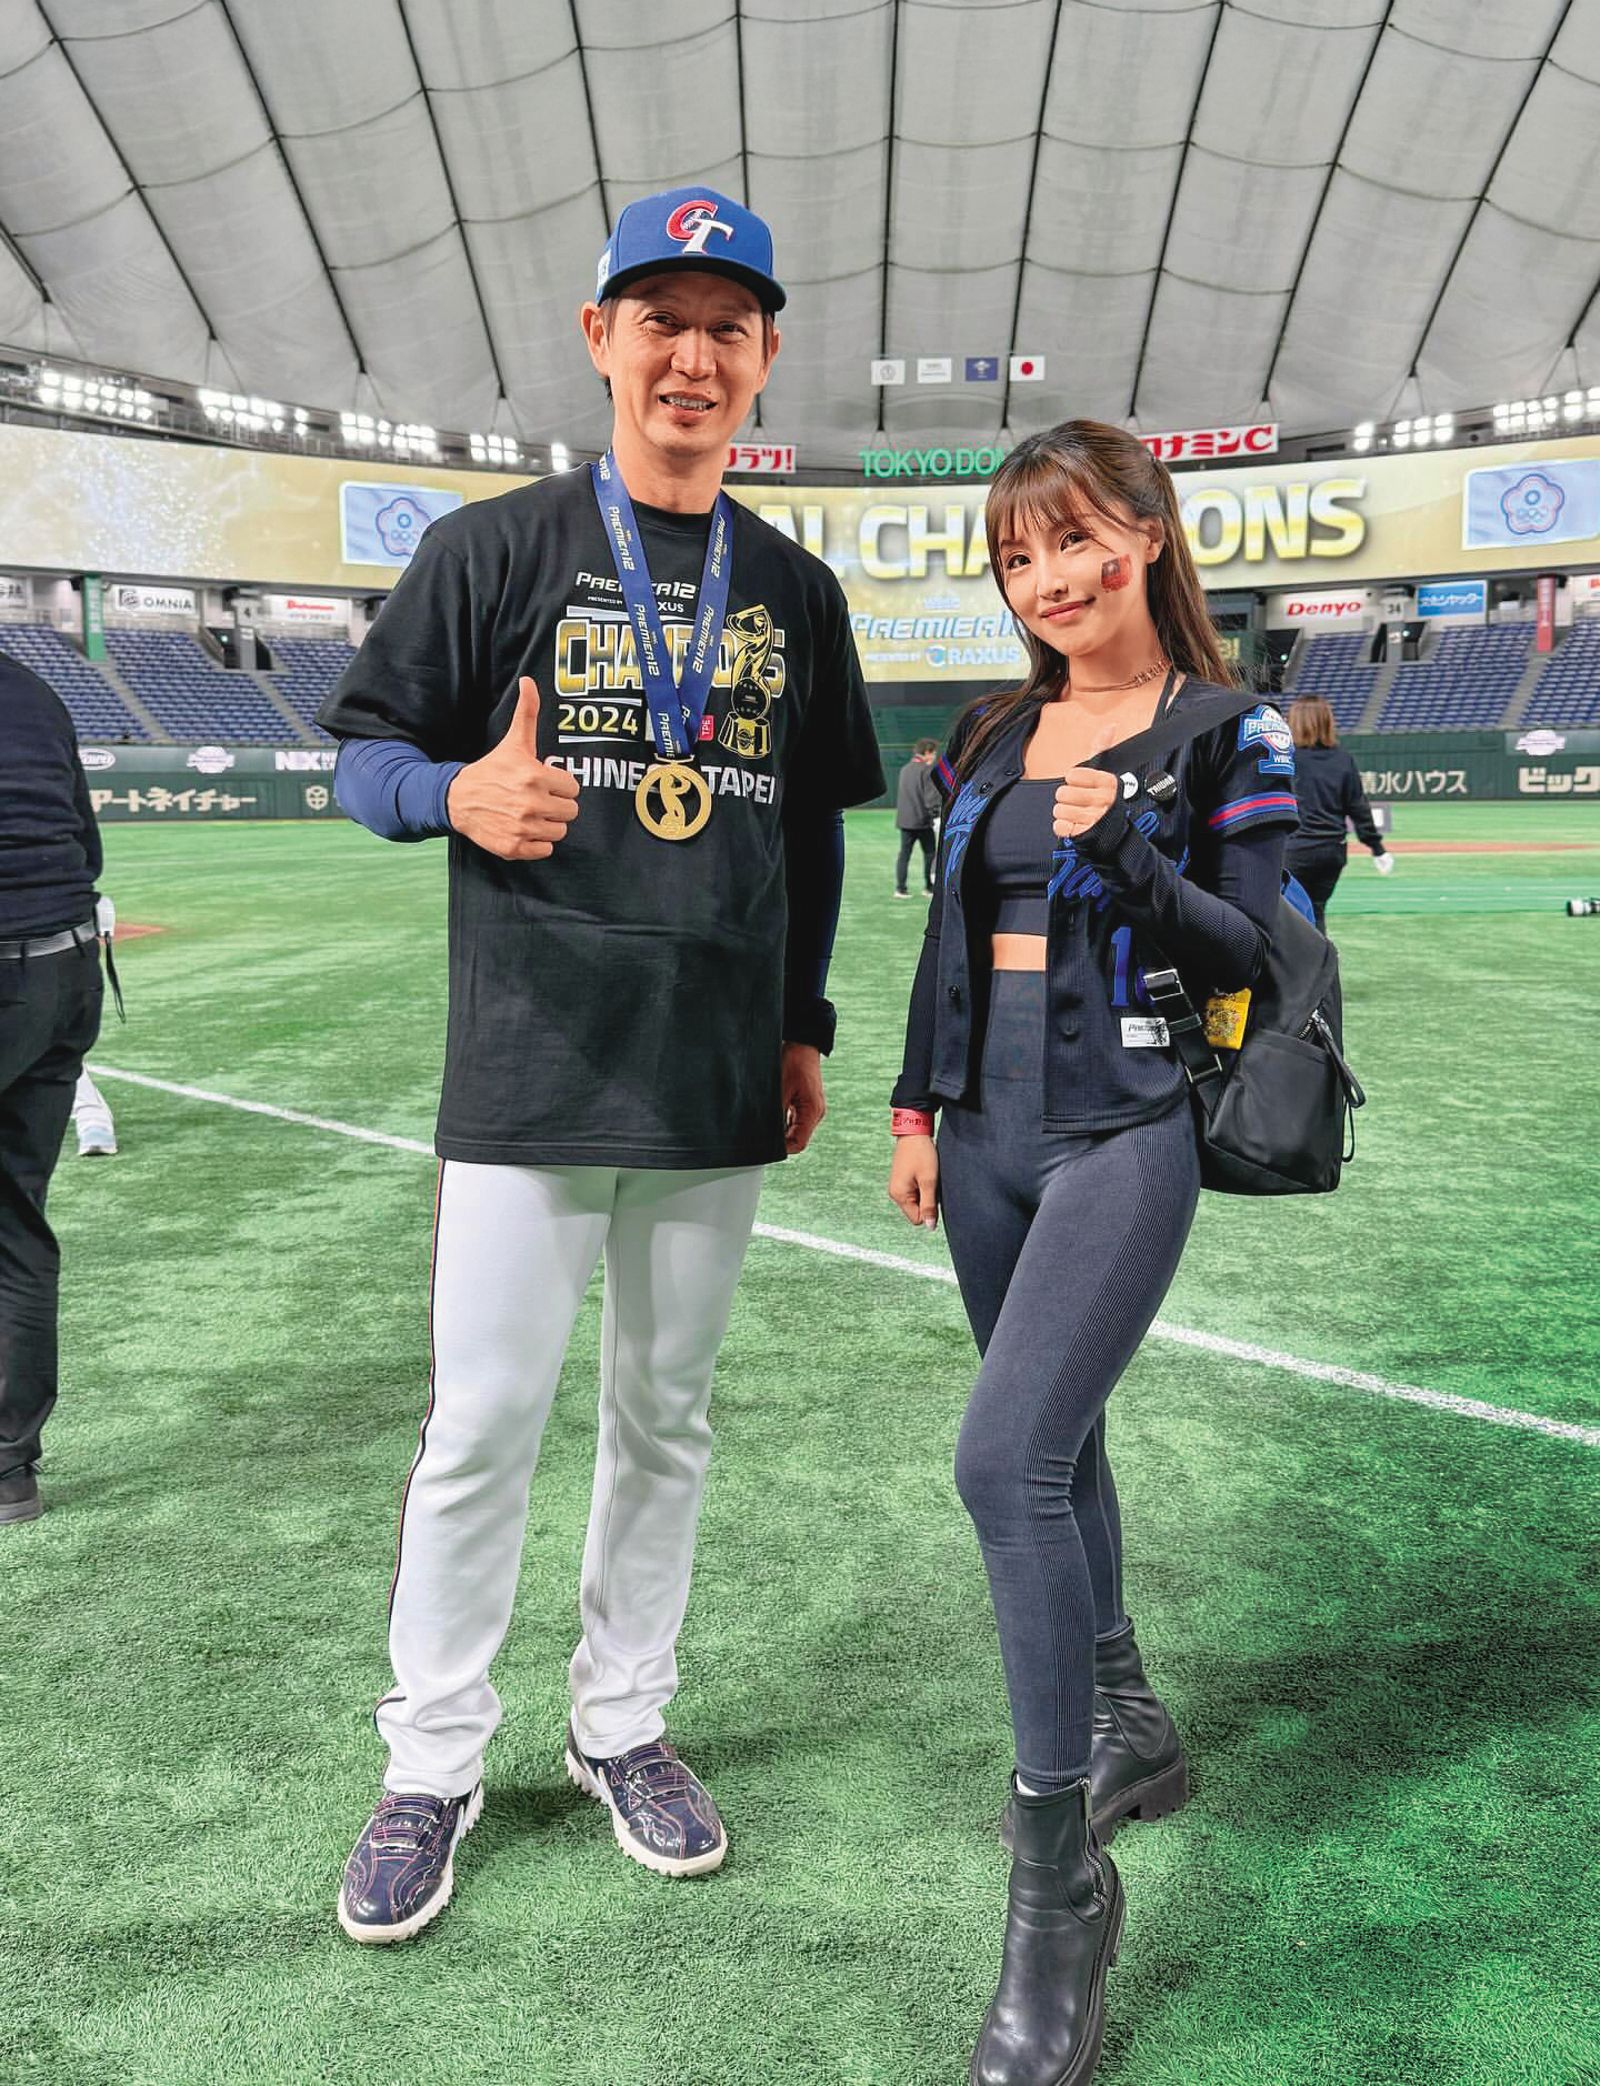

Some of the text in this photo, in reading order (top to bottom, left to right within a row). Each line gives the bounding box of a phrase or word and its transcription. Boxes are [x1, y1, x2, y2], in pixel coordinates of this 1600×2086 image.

[860, 449, 951, 478] TOKYO
[143, 598, 192, 610] OMNIA
[1286, 601, 1361, 617] Denyo
[633, 603, 660, 677] PREMIER12
[692, 604, 715, 674] PREMIER12
[948, 647, 1020, 665] RAXUS
[557, 703, 638, 736] 2024
[701, 719, 711, 736] TPE
[89, 787, 257, 812] アートネイチャー
